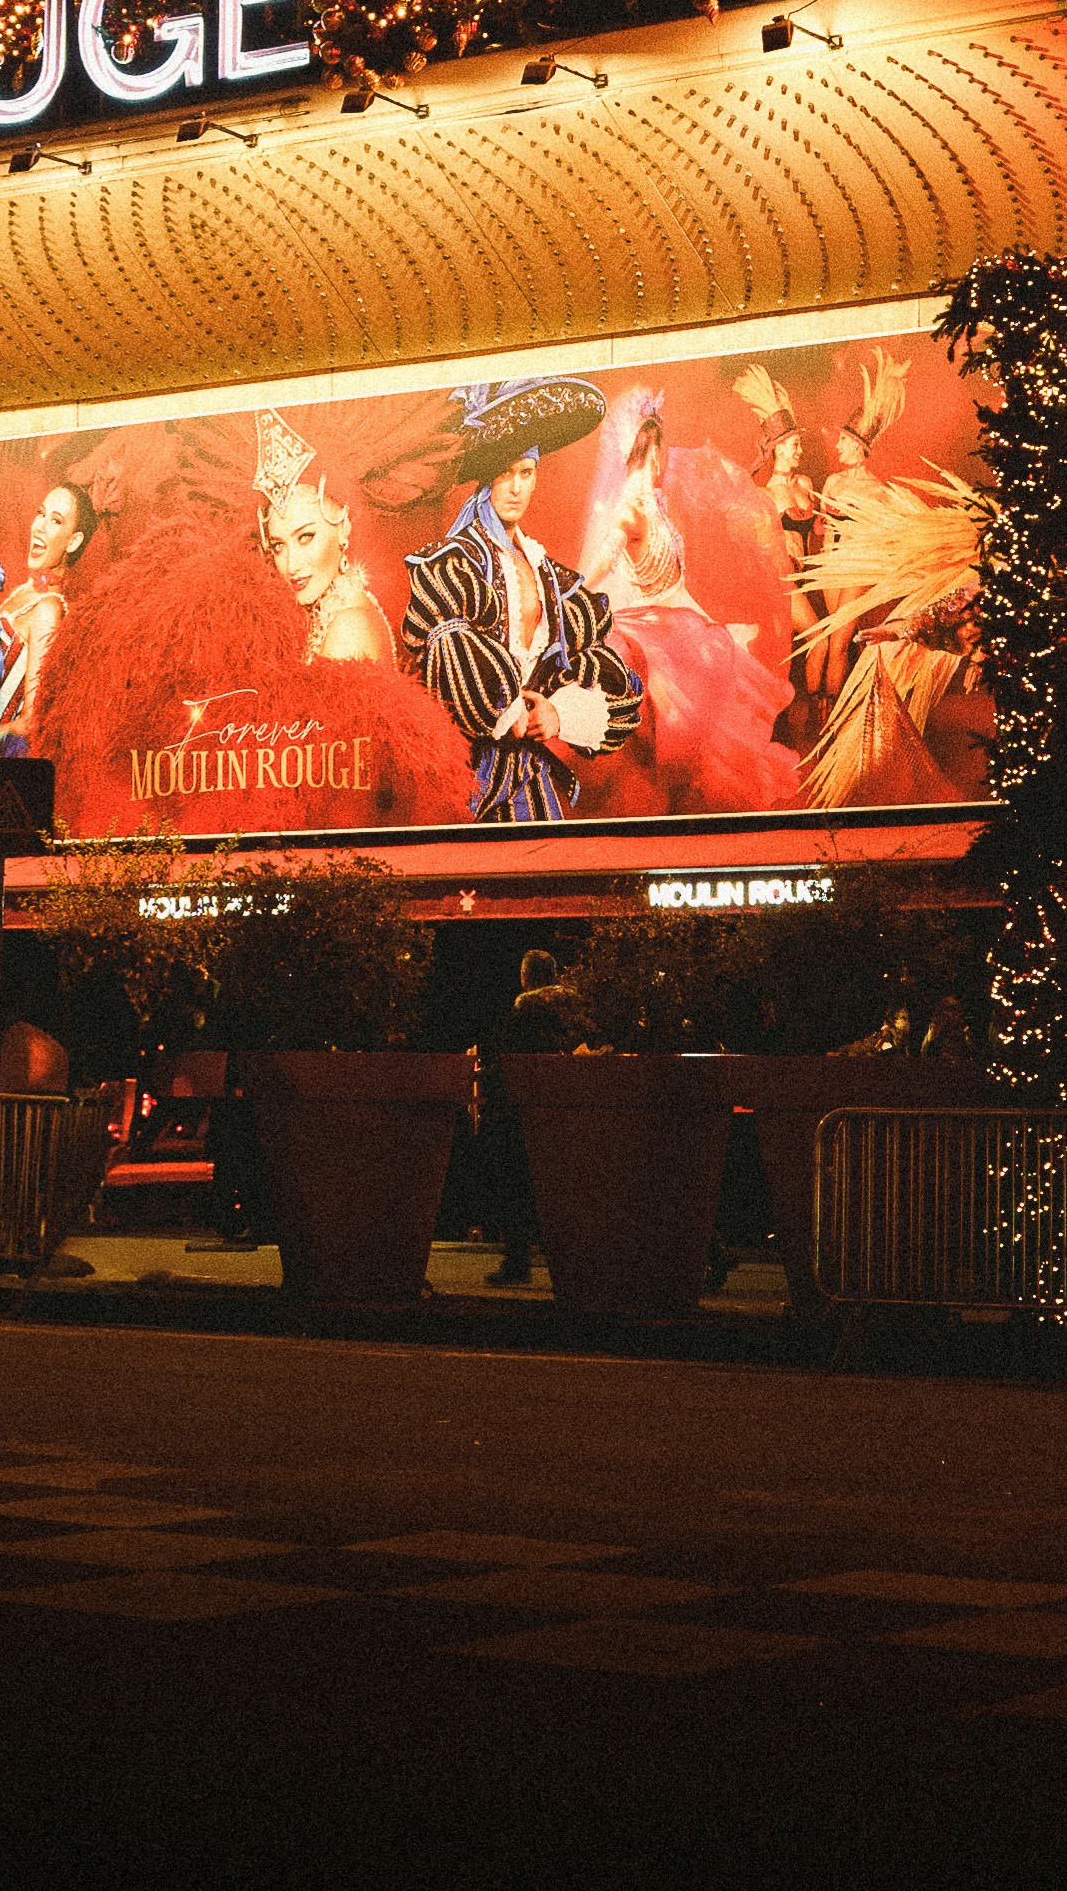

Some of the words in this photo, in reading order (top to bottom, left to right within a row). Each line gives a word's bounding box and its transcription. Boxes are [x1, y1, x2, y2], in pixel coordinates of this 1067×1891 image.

[163, 688, 325, 769] Forever
[129, 748, 249, 802] MOULIN
[255, 737, 372, 791] ROUGE
[648, 880, 744, 908] MOULIN
